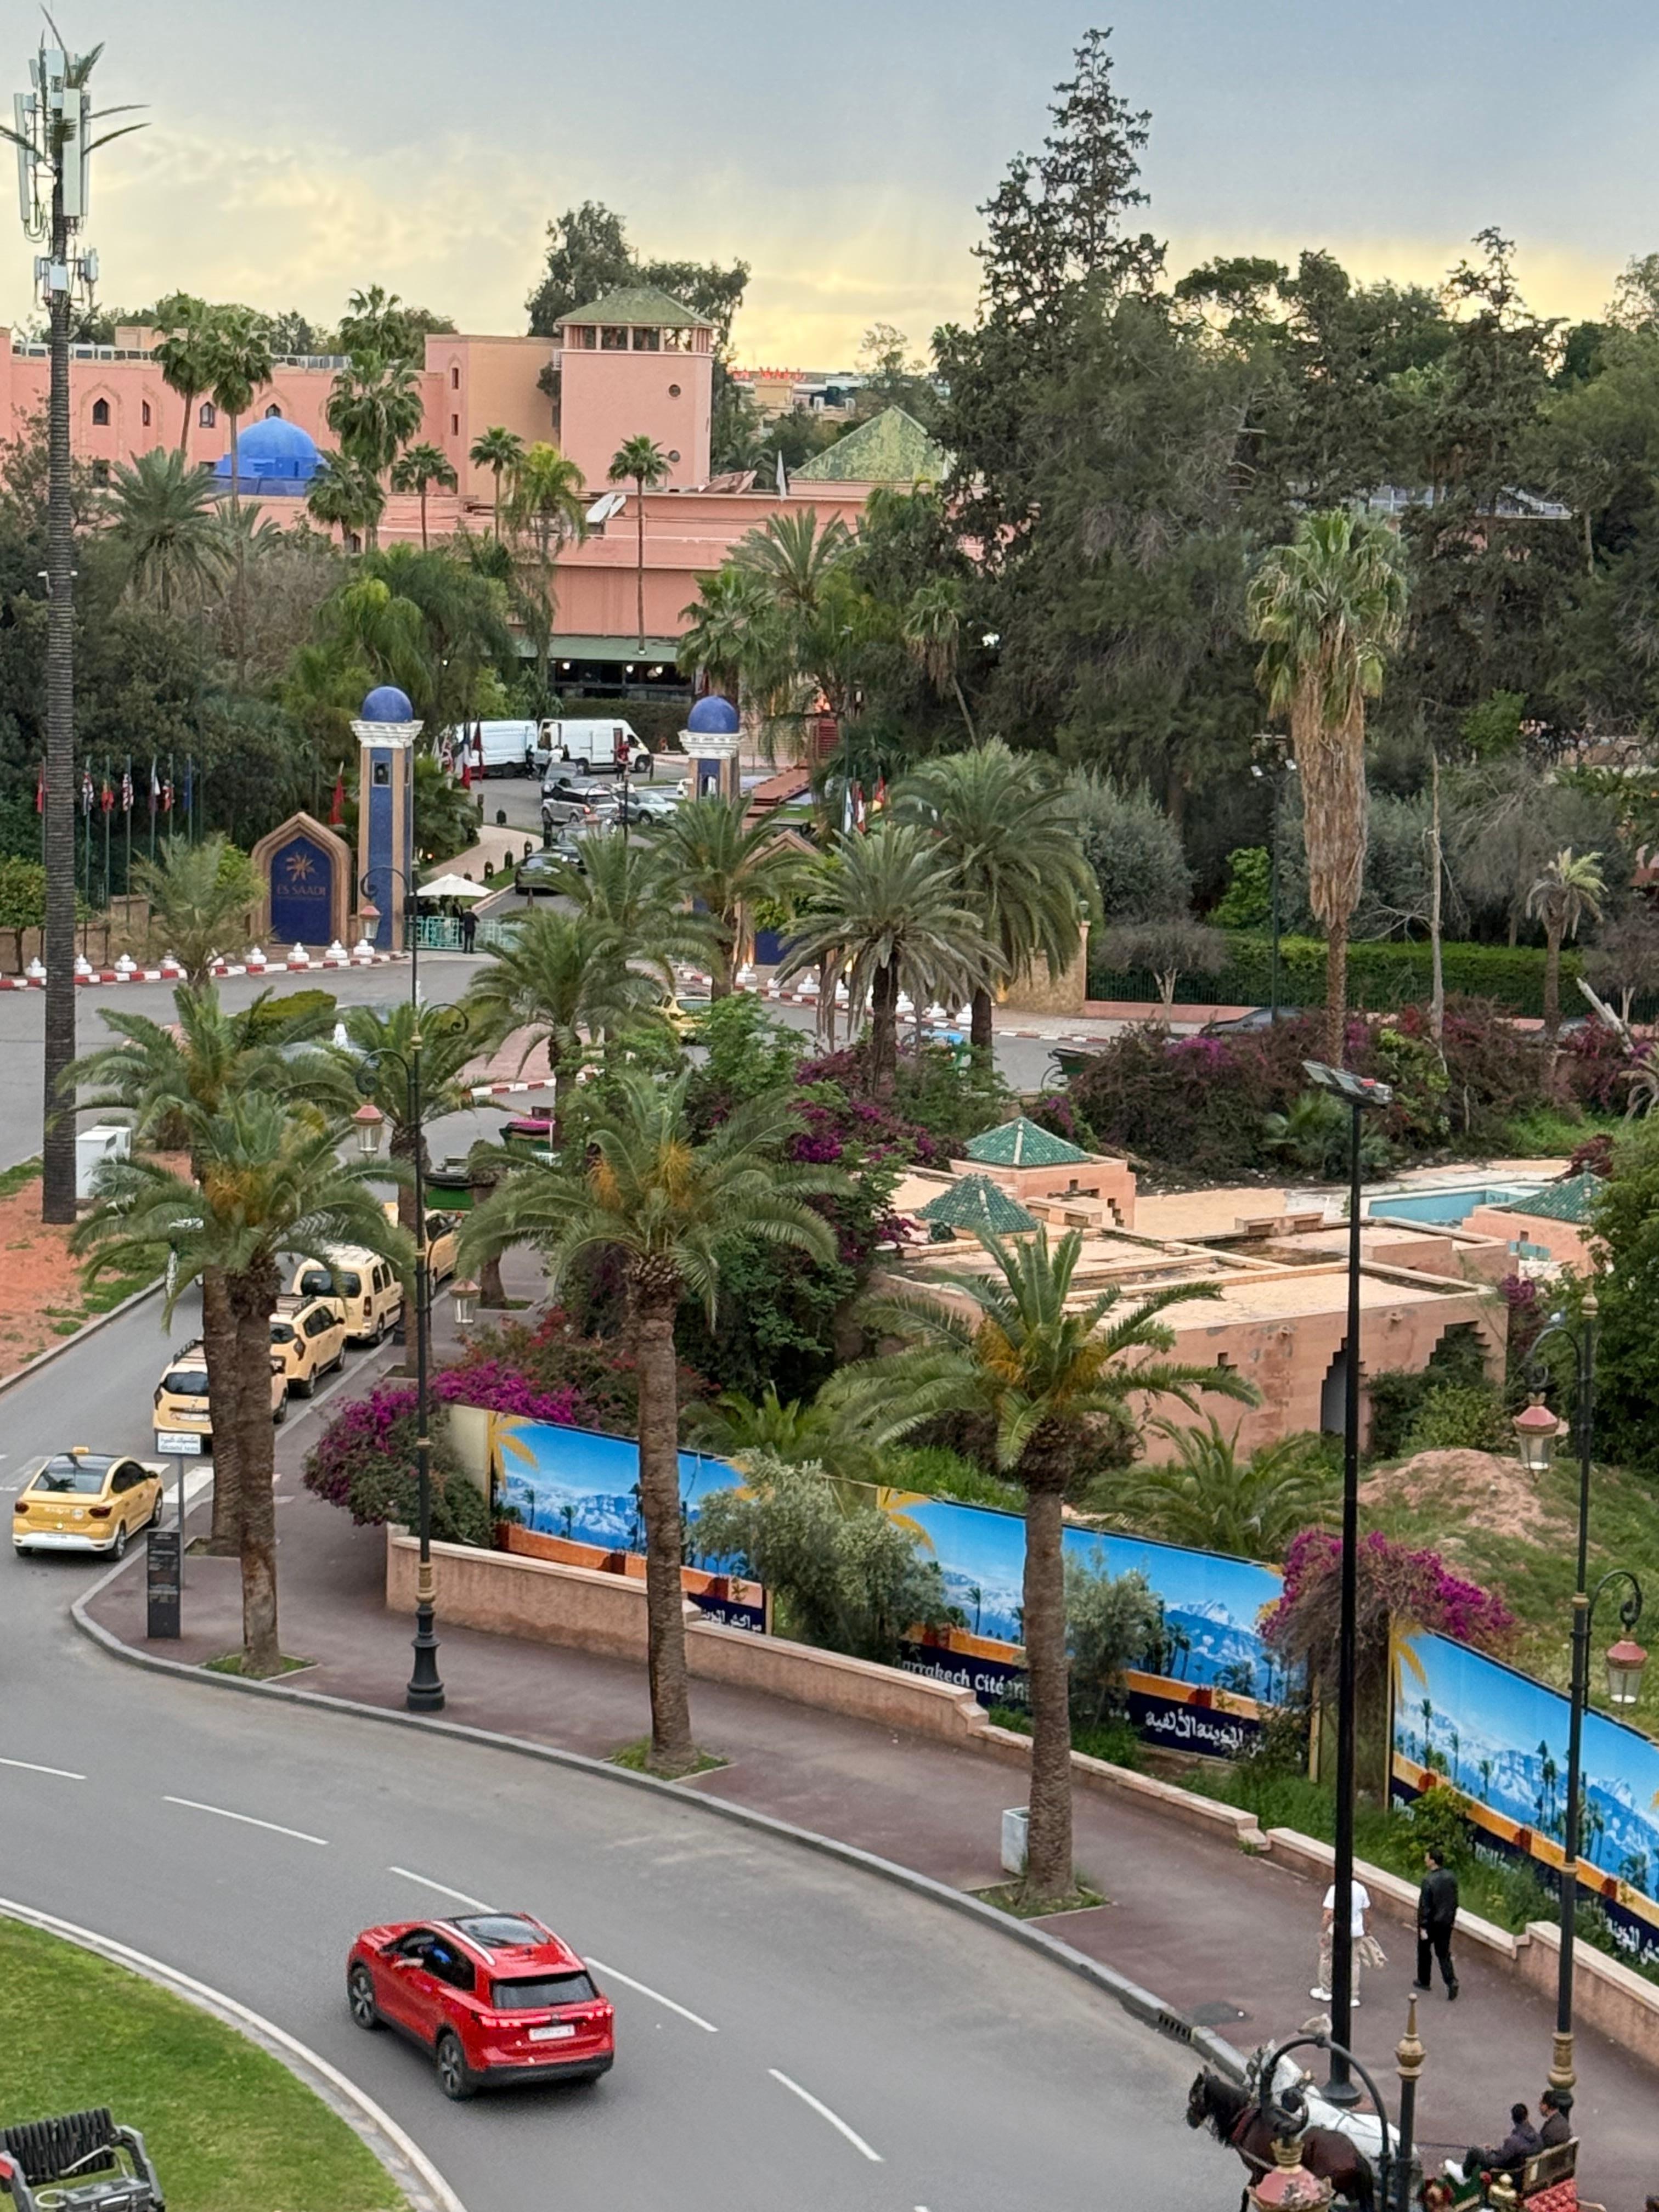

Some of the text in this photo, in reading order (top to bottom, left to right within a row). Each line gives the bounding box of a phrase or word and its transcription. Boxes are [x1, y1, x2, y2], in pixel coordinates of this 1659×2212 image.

[276, 884, 326, 896] ES SAADI
[901, 1661, 970, 1688] arrakech
[974, 1673, 1005, 1696] Cité
